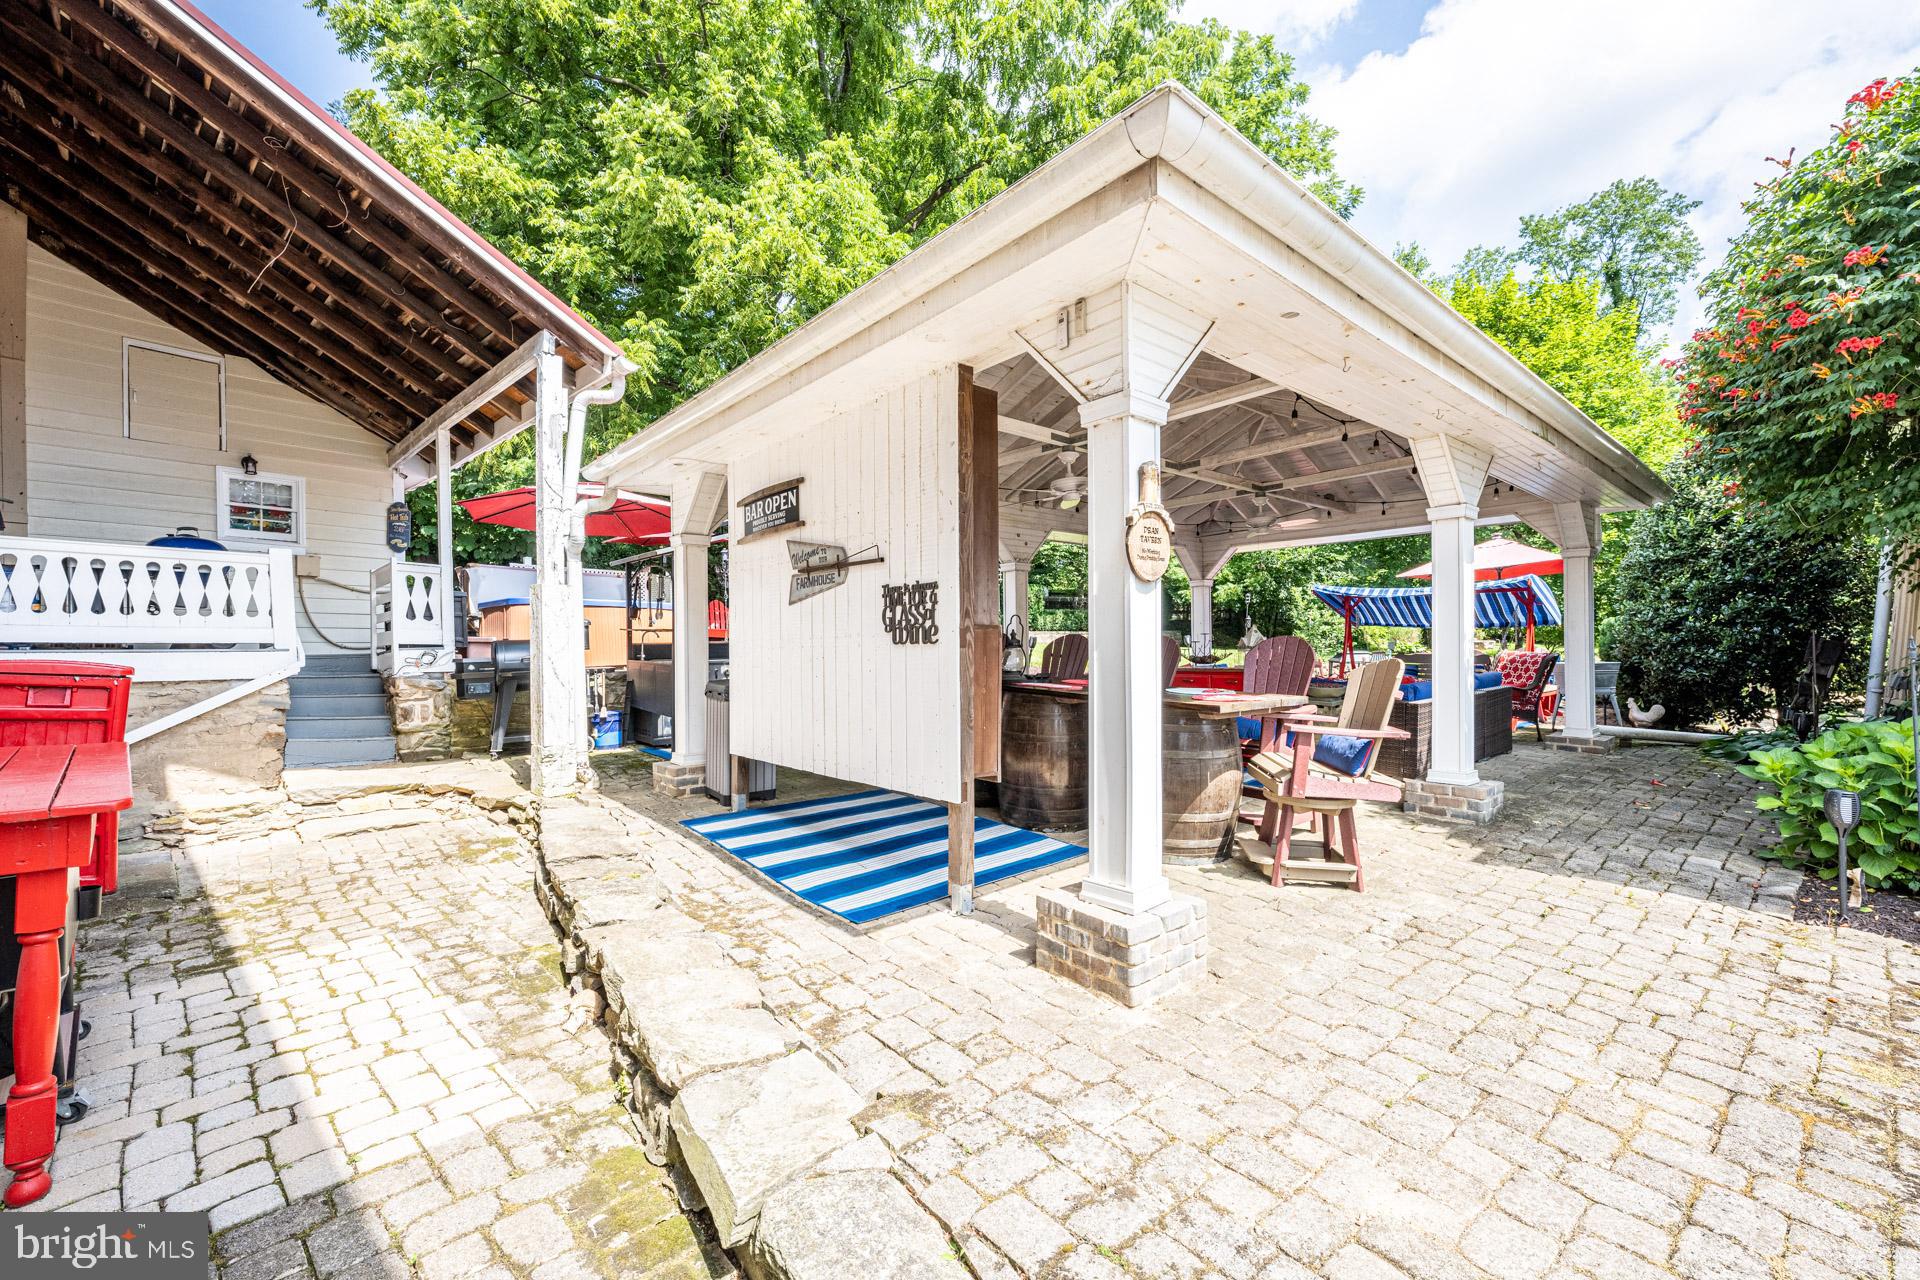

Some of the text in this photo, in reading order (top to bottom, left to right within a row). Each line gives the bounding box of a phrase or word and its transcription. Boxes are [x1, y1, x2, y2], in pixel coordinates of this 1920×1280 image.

[745, 489, 797, 523] BAR OPEN
[791, 546, 820, 566] Welcome
[795, 572, 836, 591] FARMHOUSE
[881, 603, 927, 627] GLASS
